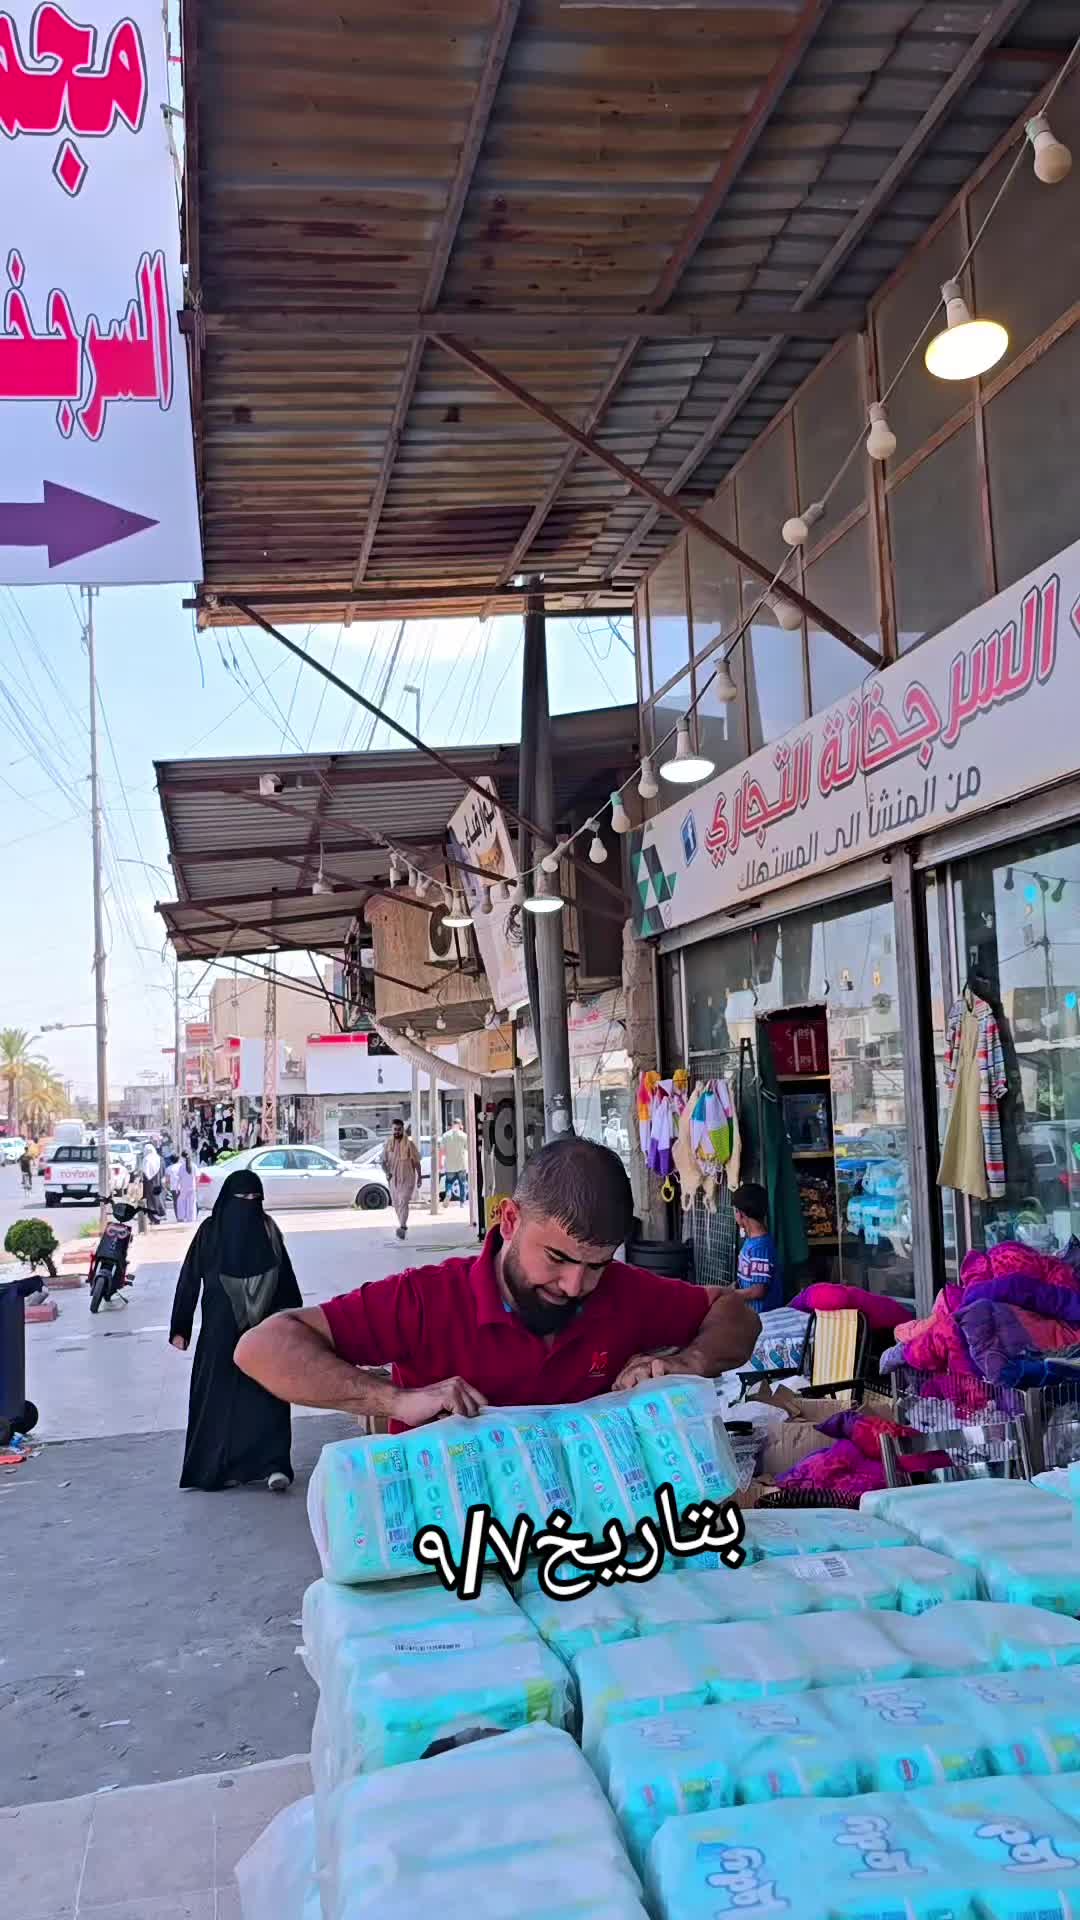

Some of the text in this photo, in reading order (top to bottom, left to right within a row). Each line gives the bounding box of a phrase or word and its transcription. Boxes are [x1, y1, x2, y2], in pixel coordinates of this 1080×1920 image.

[704, 573, 1060, 869] السرجخانة التجاري
[737, 765, 981, 891] من المنشأ الى المستهلك
